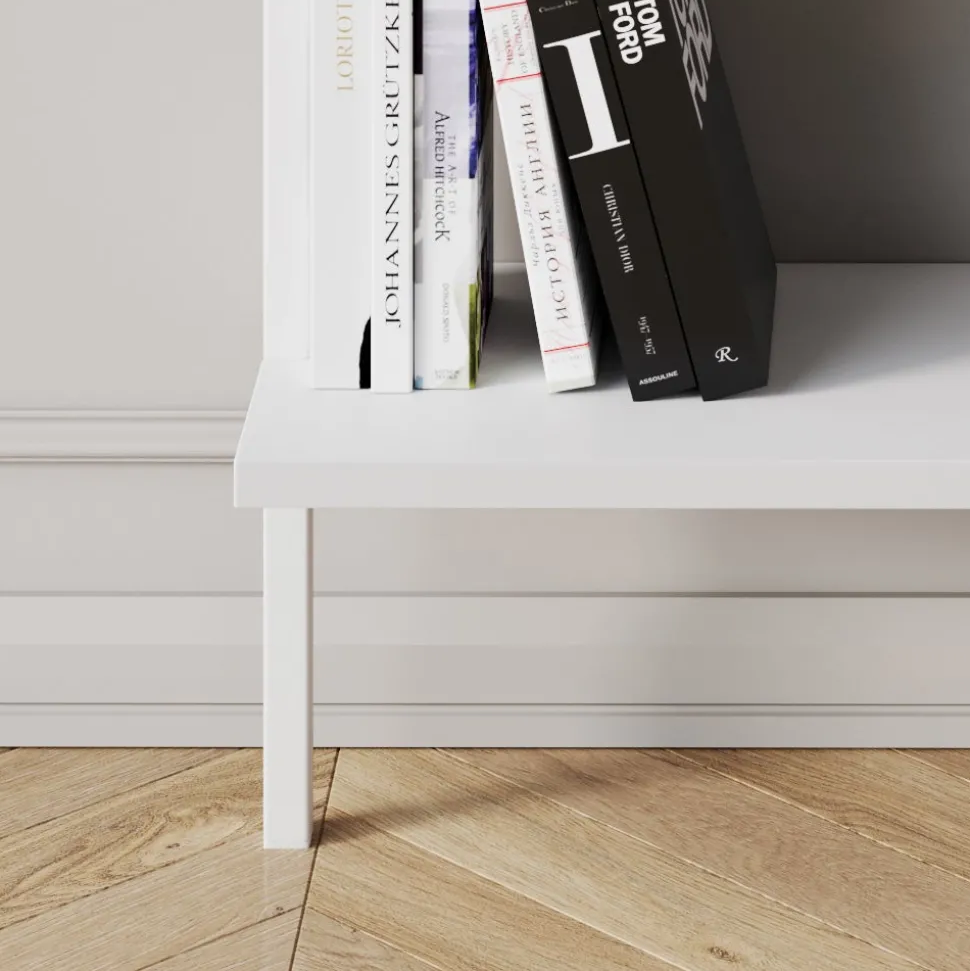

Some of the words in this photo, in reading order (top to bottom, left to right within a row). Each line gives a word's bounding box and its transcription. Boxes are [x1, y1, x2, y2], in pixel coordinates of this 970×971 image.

[608, 0, 644, 65] FORD
[435, 111, 451, 162] ALFRED
[448, 135, 457, 158] THE
[520, 104, 547, 197] АНГЛИИ
[435, 165, 451, 242] HITCHCOCK
[448, 200, 457, 216] OF
[602, 183, 626, 244] CHRISTIAN
[618, 244, 635, 274] DIOR
[385, 155, 401, 328] JOHANNES
[538, 210, 569, 321] ИСТОРИЯ
[639, 370, 679, 386] ASSOULINE
[715, 346, 739, 363] R
